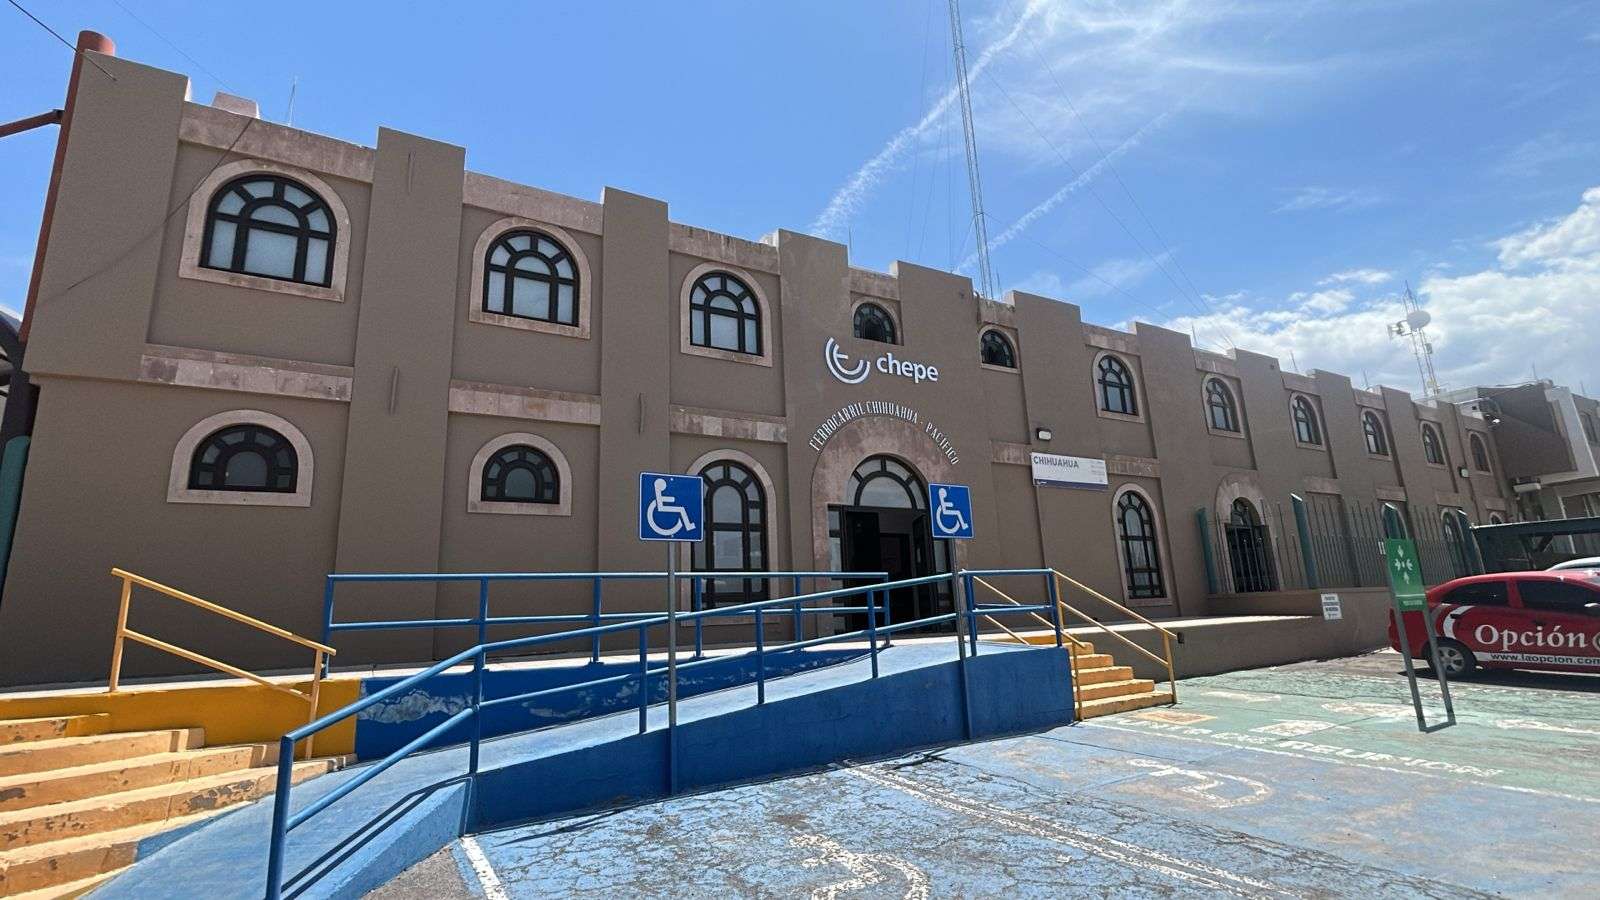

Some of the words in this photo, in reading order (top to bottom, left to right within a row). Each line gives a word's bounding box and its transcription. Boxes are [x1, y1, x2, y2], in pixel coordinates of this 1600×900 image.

[876, 352, 939, 383] chepe
[809, 402, 866, 451] FERROCARRIL
[866, 402, 918, 424] CHIHUAHUA
[1033, 455, 1079, 468] CHIHUAHUA
[1474, 624, 1588, 652] Opción
